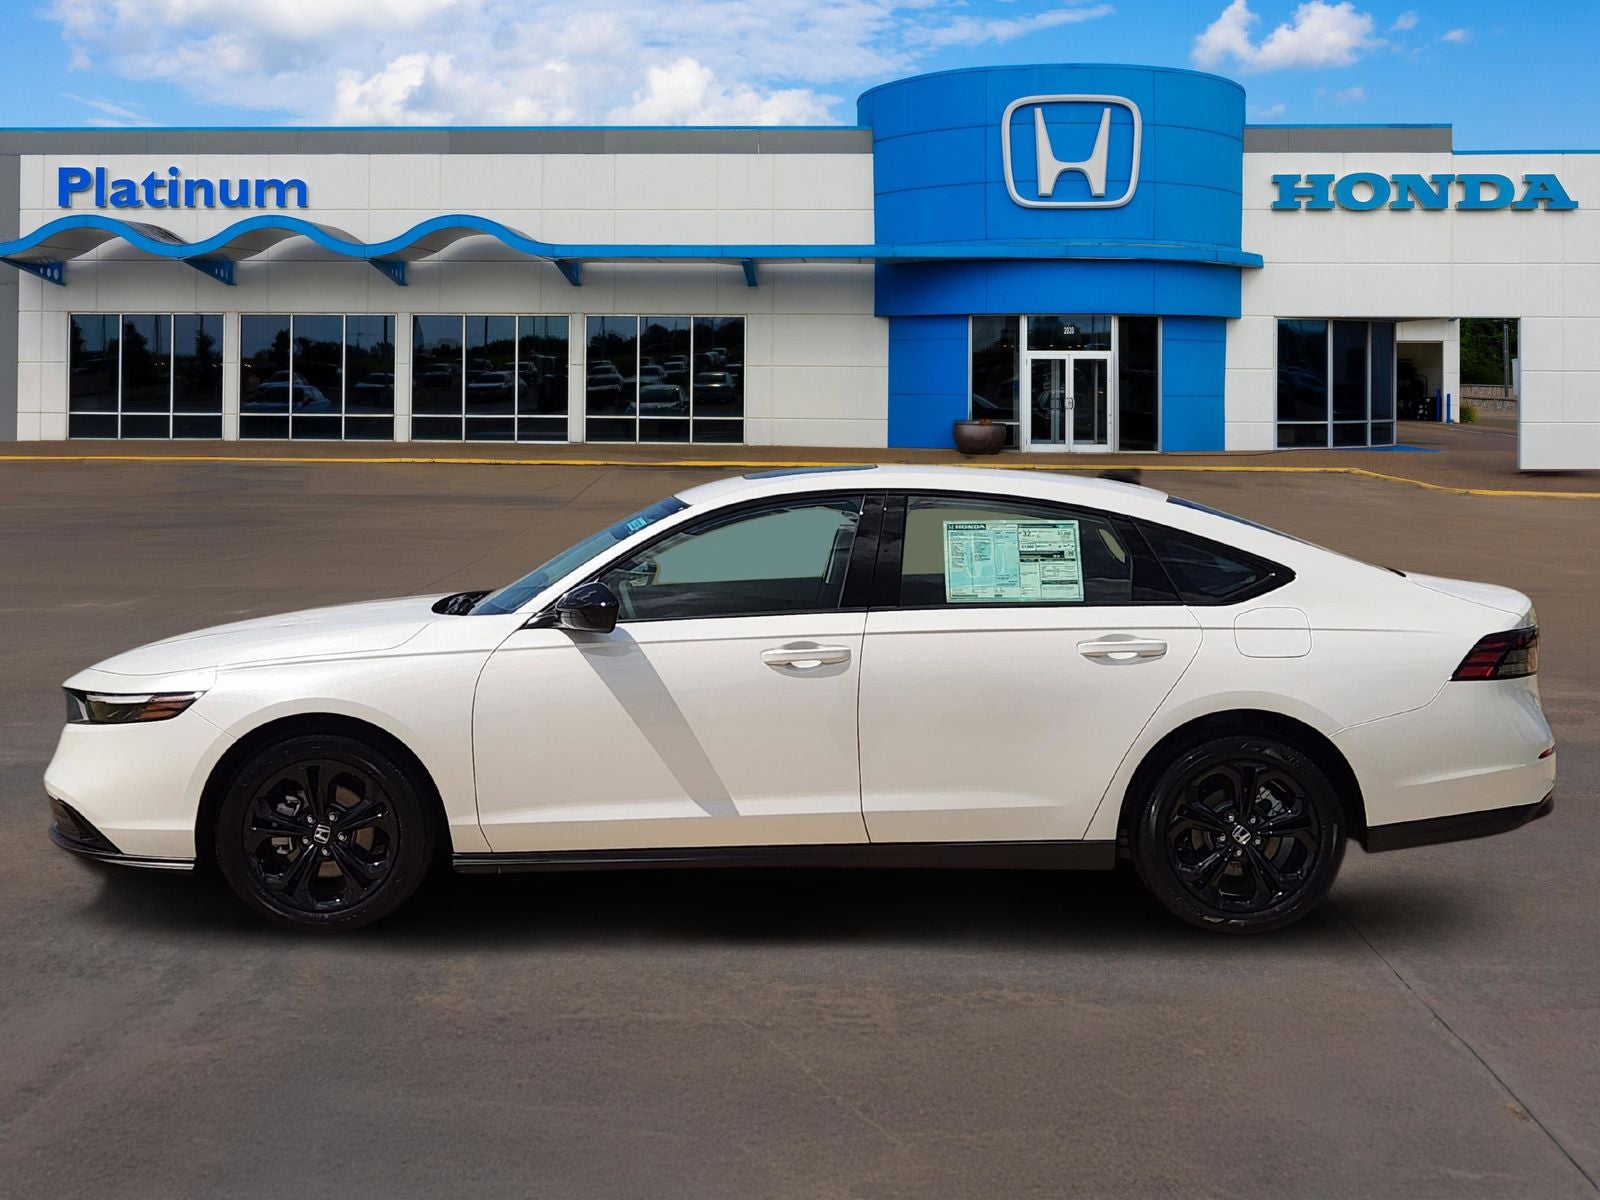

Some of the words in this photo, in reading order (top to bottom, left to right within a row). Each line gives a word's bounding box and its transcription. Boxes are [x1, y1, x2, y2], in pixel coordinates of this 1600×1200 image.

[58, 166, 308, 208] Platinum
[1271, 172, 1578, 211] HONDA
[1064, 326, 1074, 334] 2020
